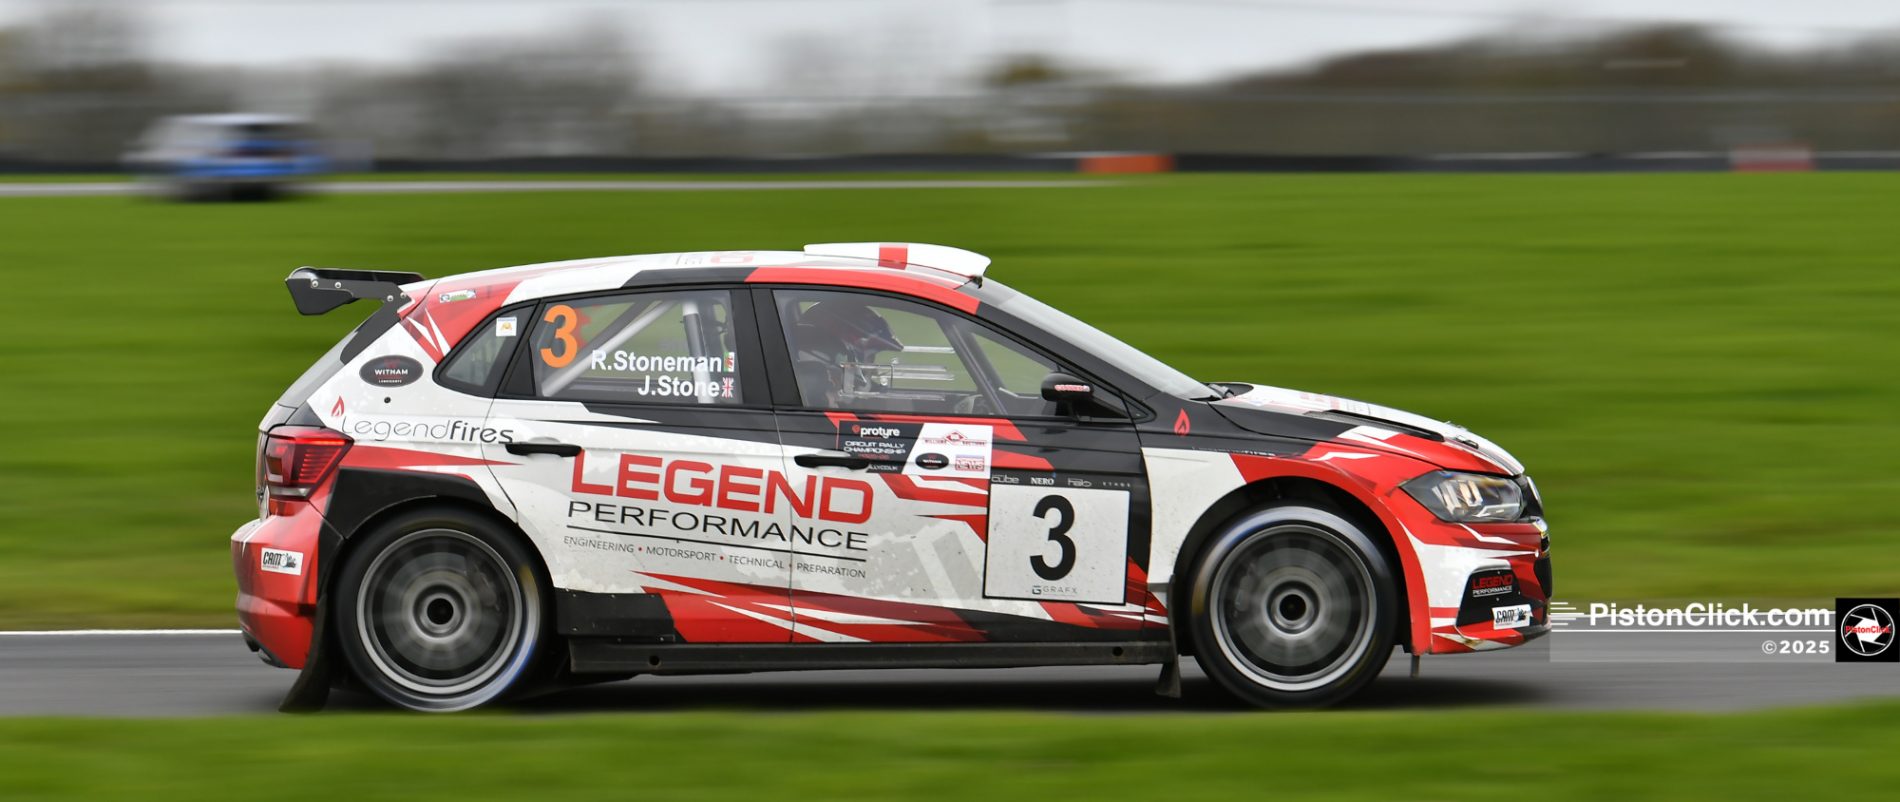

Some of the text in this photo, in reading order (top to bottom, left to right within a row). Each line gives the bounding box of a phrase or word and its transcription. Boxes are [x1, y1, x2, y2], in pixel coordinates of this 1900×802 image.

[540, 304, 578, 368] 3
[592, 350, 722, 372] R.Stoneman
[638, 376, 720, 396] J.Stone
[860, 426, 900, 439] protyre
[843, 446, 906, 454] CHAMPIONSHIP
[845, 440, 877, 448] CIRCUIT
[571, 449, 874, 524] LEGEND
[1030, 476, 1055, 486] NERO
[567, 500, 869, 551] PERFORMANCE
[1030, 494, 1077, 581] 3
[563, 536, 867, 578] ENGINEERING MOTORSPORT TECHNICAL PREPARATION
[1472, 574, 1514, 589] LEGEND
[1472, 585, 1513, 595] PERFORMANCE
